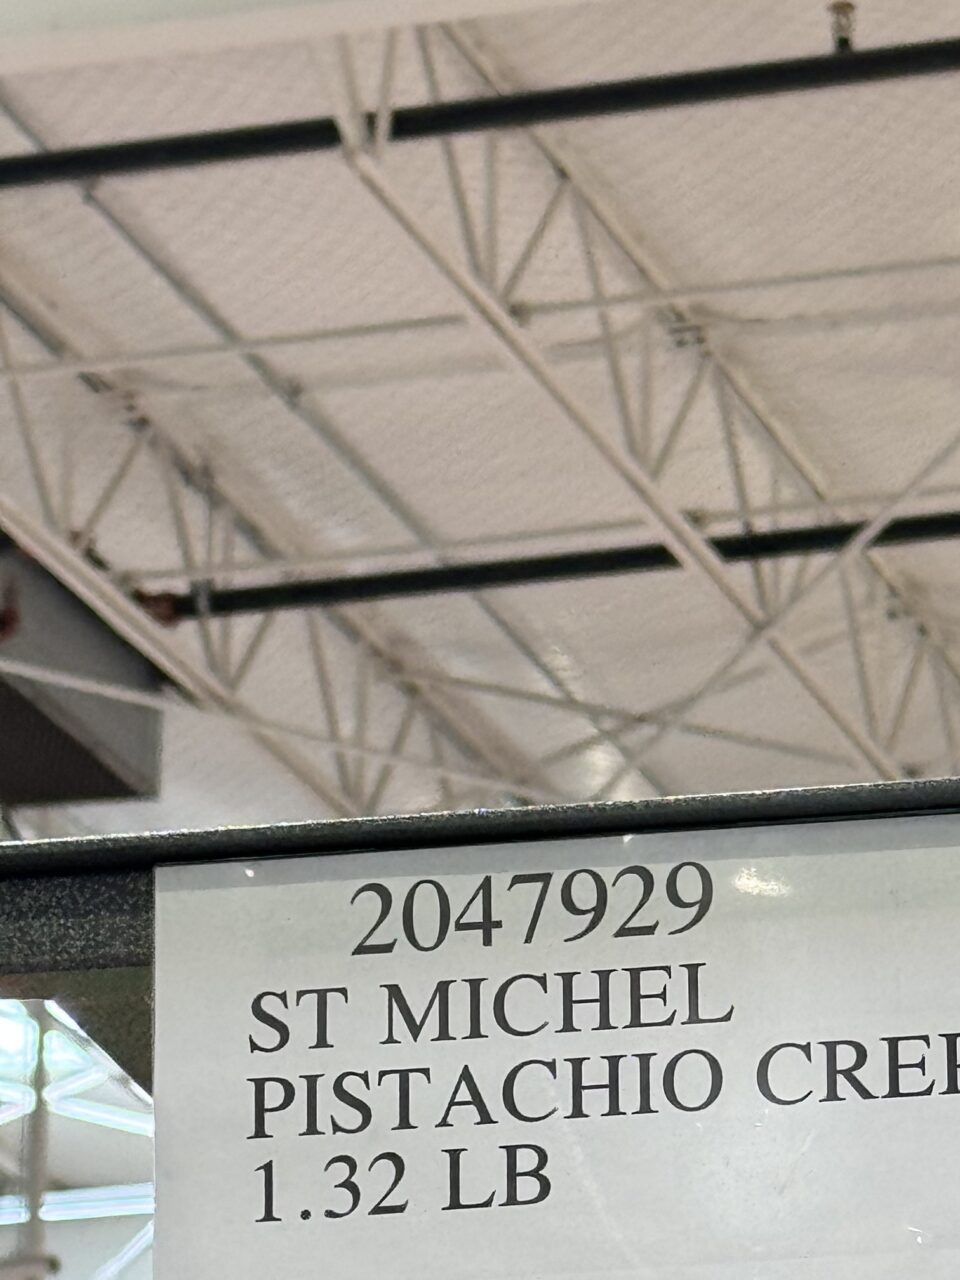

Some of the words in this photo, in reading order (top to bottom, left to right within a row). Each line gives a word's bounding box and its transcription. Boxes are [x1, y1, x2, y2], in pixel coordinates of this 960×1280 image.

[351, 862, 713, 955] 2047929
[249, 987, 348, 1053] ST
[380, 961, 734, 1044] MICHEL
[247, 1047, 722, 1139] PISTACHIO
[255, 1152, 408, 1222] 1.32
[441, 1144, 551, 1210] LB
